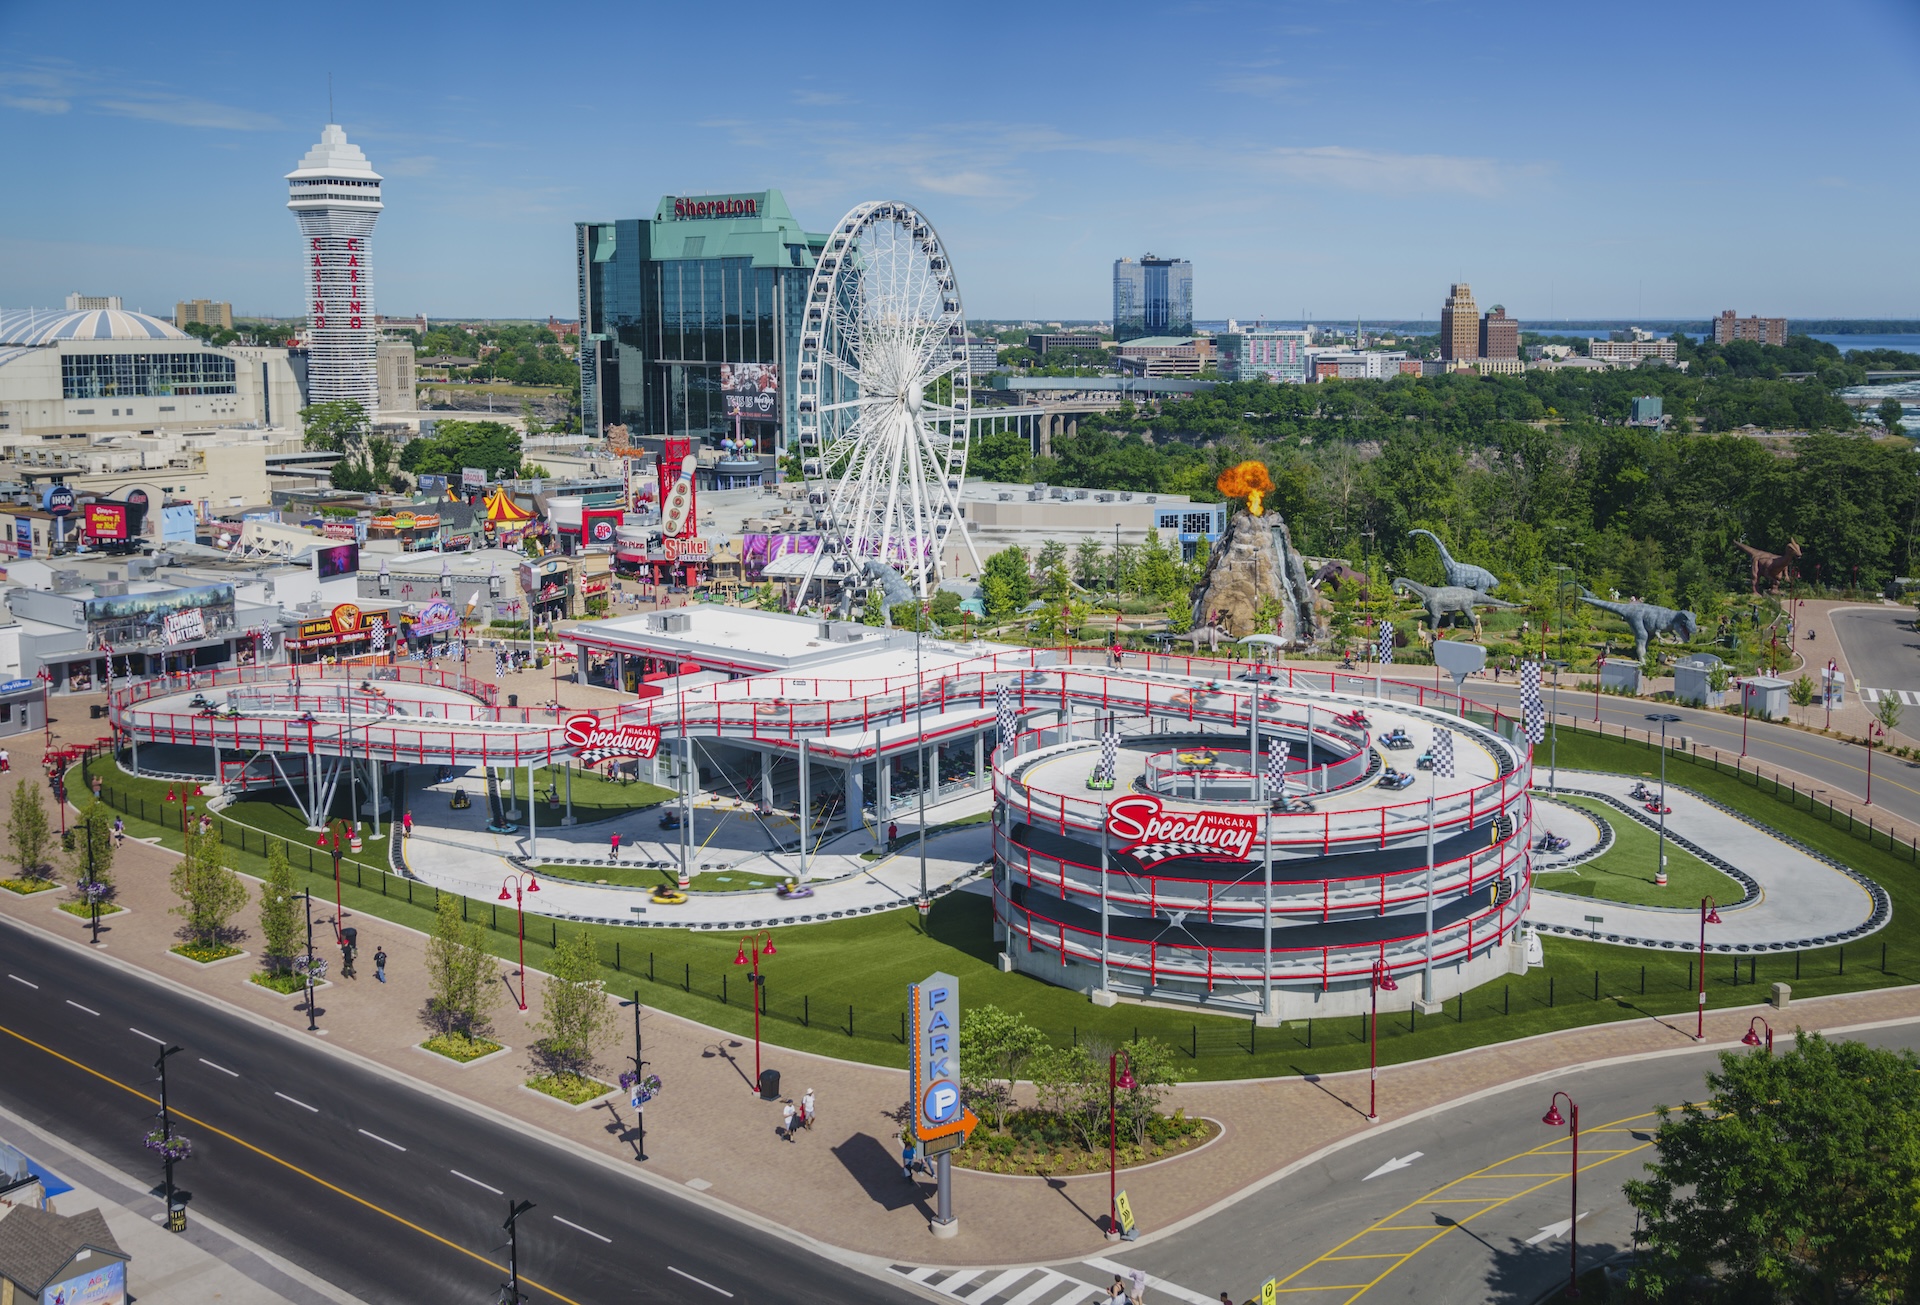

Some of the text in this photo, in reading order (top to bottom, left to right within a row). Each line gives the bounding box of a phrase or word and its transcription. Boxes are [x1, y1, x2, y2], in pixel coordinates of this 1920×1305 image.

[675, 198, 756, 217] Sheraton
[313, 238, 325, 328] CASINO
[347, 238, 361, 328] CASINO
[745, 395, 753, 407] IS
[52, 495, 71, 506] IHOP
[667, 484, 686, 531] BOWL
[323, 525, 353, 535] Thriftlodge
[665, 539, 706, 560] Strike!
[168, 610, 201, 632] ZOMBIE
[316, 623, 331, 632] Dogs
[176, 624, 204, 641] ATTACK
[2, 681, 30, 690] SkyWheel
[565, 717, 656, 758] Speedway
[627, 728, 656, 737] NIAGARA
[1109, 799, 1253, 857] Speedway
[1207, 815, 1253, 829] NIAGARA
[928, 987, 950, 1080] PARK
[934, 1088, 956, 1118] P
